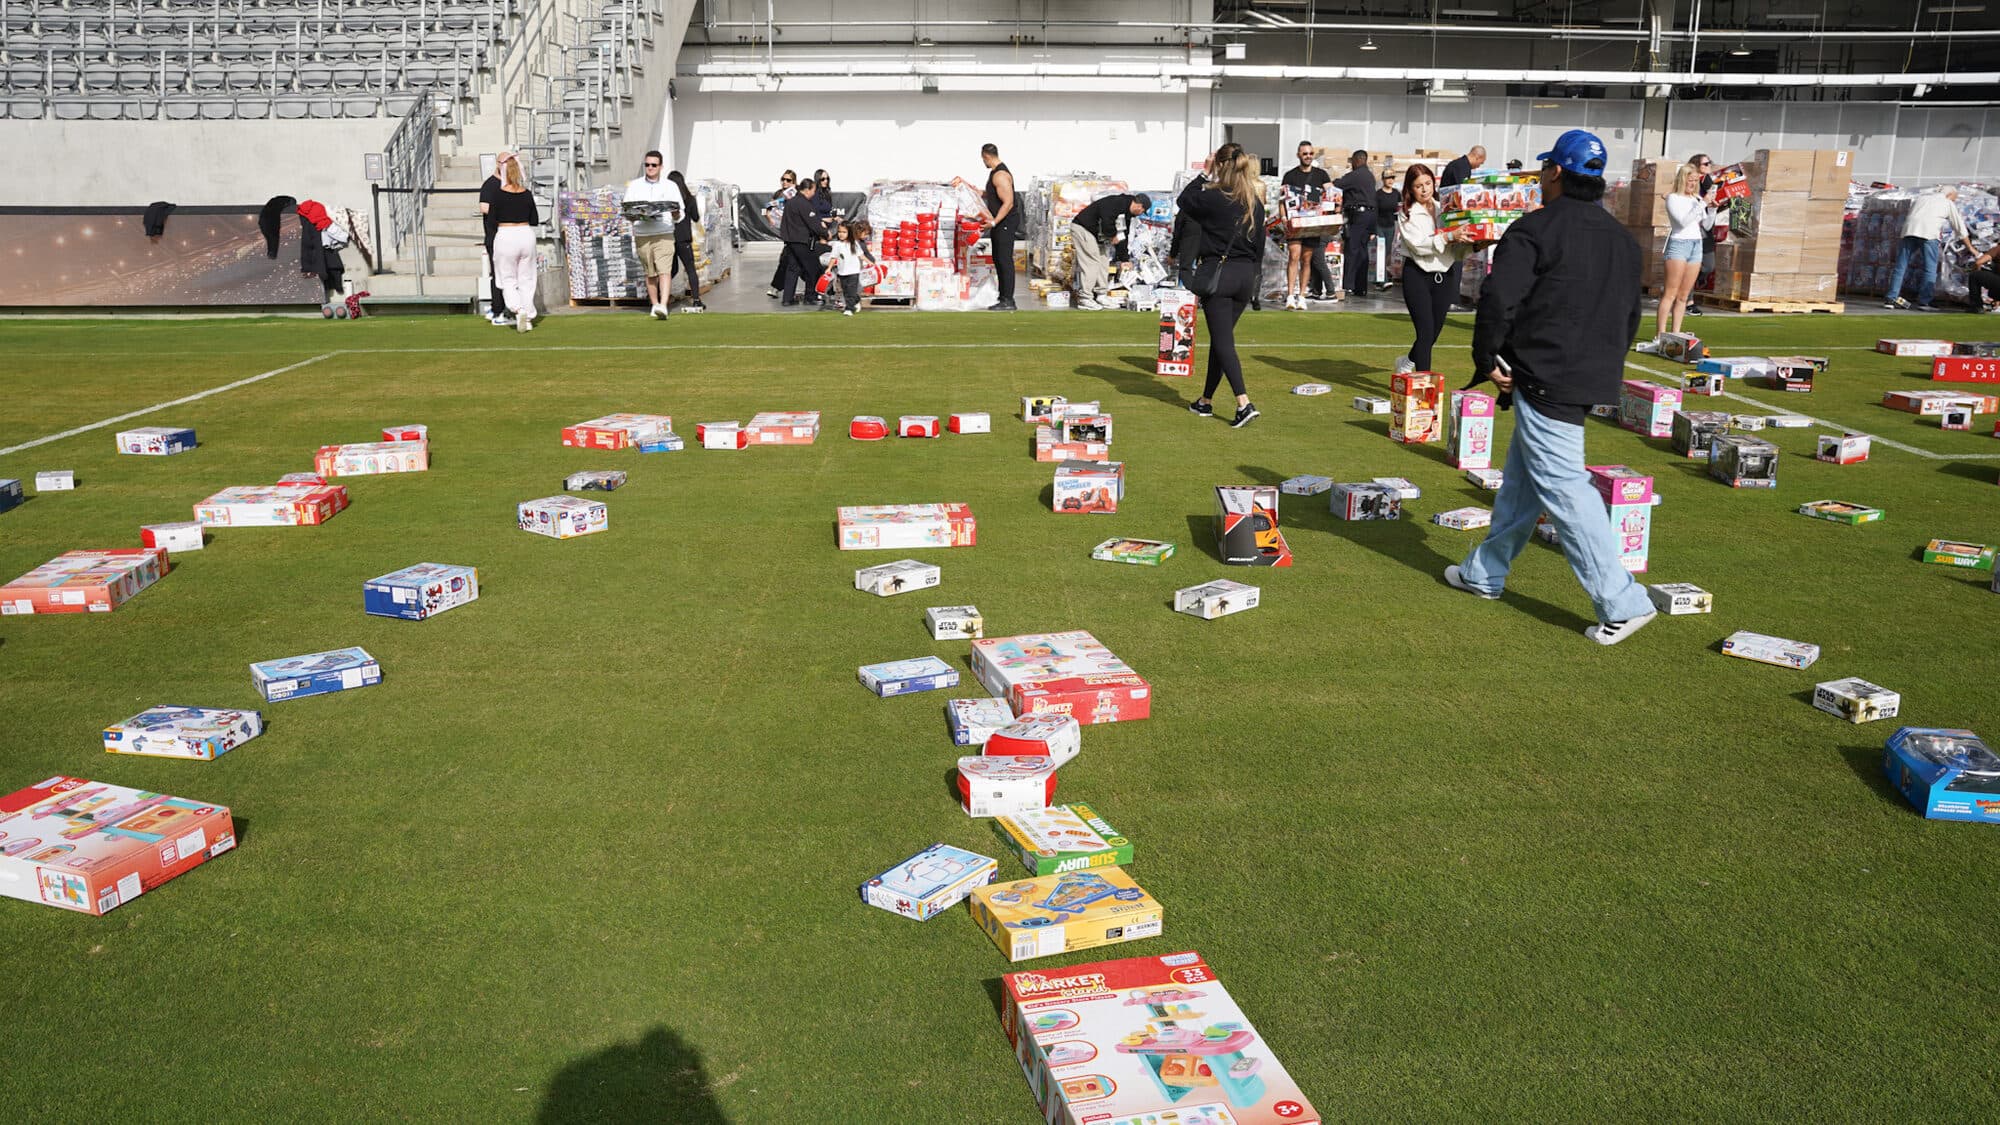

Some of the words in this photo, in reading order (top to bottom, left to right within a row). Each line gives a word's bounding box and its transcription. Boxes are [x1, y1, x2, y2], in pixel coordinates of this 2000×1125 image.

[1962, 363, 1996, 372] SON
[1934, 554, 1980, 567] SUBWAY
[1816, 691, 1834, 703] WARS
[1817, 687, 1834, 697] STAR
[1033, 703, 1073, 714] MARKET
[1053, 852, 1119, 873] SUBWAY
[1136, 922, 1160, 930] WARNING
[1181, 968, 1204, 977] 33
[1020, 975, 1102, 994] MARKET
[1186, 975, 1207, 983] PCS
[1062, 985, 1109, 996] stand
[1278, 1104, 1299, 1115] 3+
